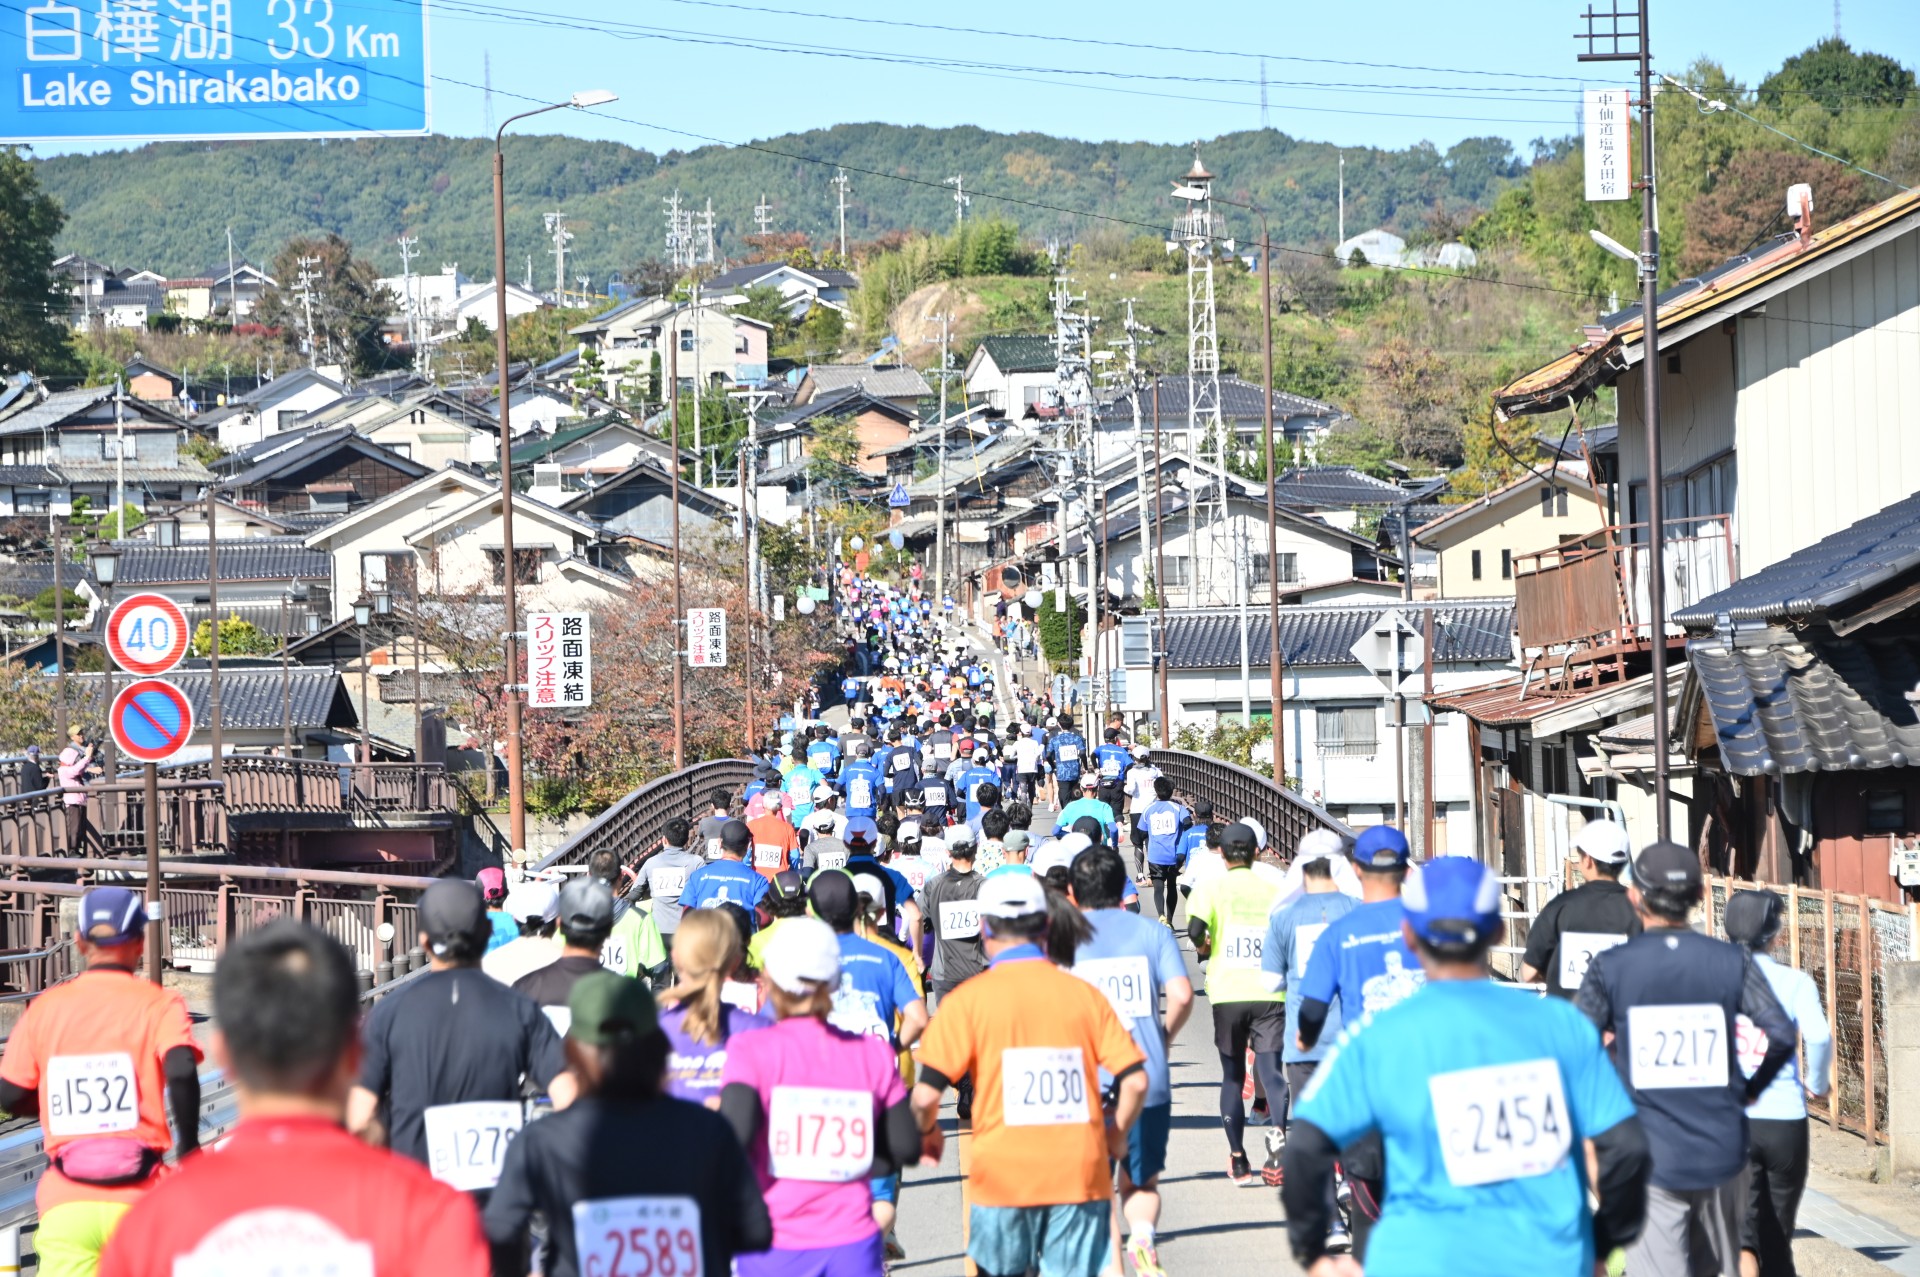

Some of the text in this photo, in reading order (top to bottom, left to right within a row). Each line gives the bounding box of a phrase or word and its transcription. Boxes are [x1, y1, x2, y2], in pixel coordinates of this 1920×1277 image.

[25, 0, 400, 63] 白樺湖 33 Km
[22, 68, 361, 107] Lake Shirakabako
[1598, 92, 1616, 195] 中仙道塩名田宿
[126, 617, 169, 651] 40
[535, 616, 557, 704] スリップ注意
[562, 616, 584, 702] 路面凍結
[692, 610, 706, 664] スリップ注意
[708, 611, 722, 664] 路面凍結
[51, 1074, 132, 1117] B1532
[775, 1113, 867, 1160] B1739
[585, 1226, 699, 1277] C2589
